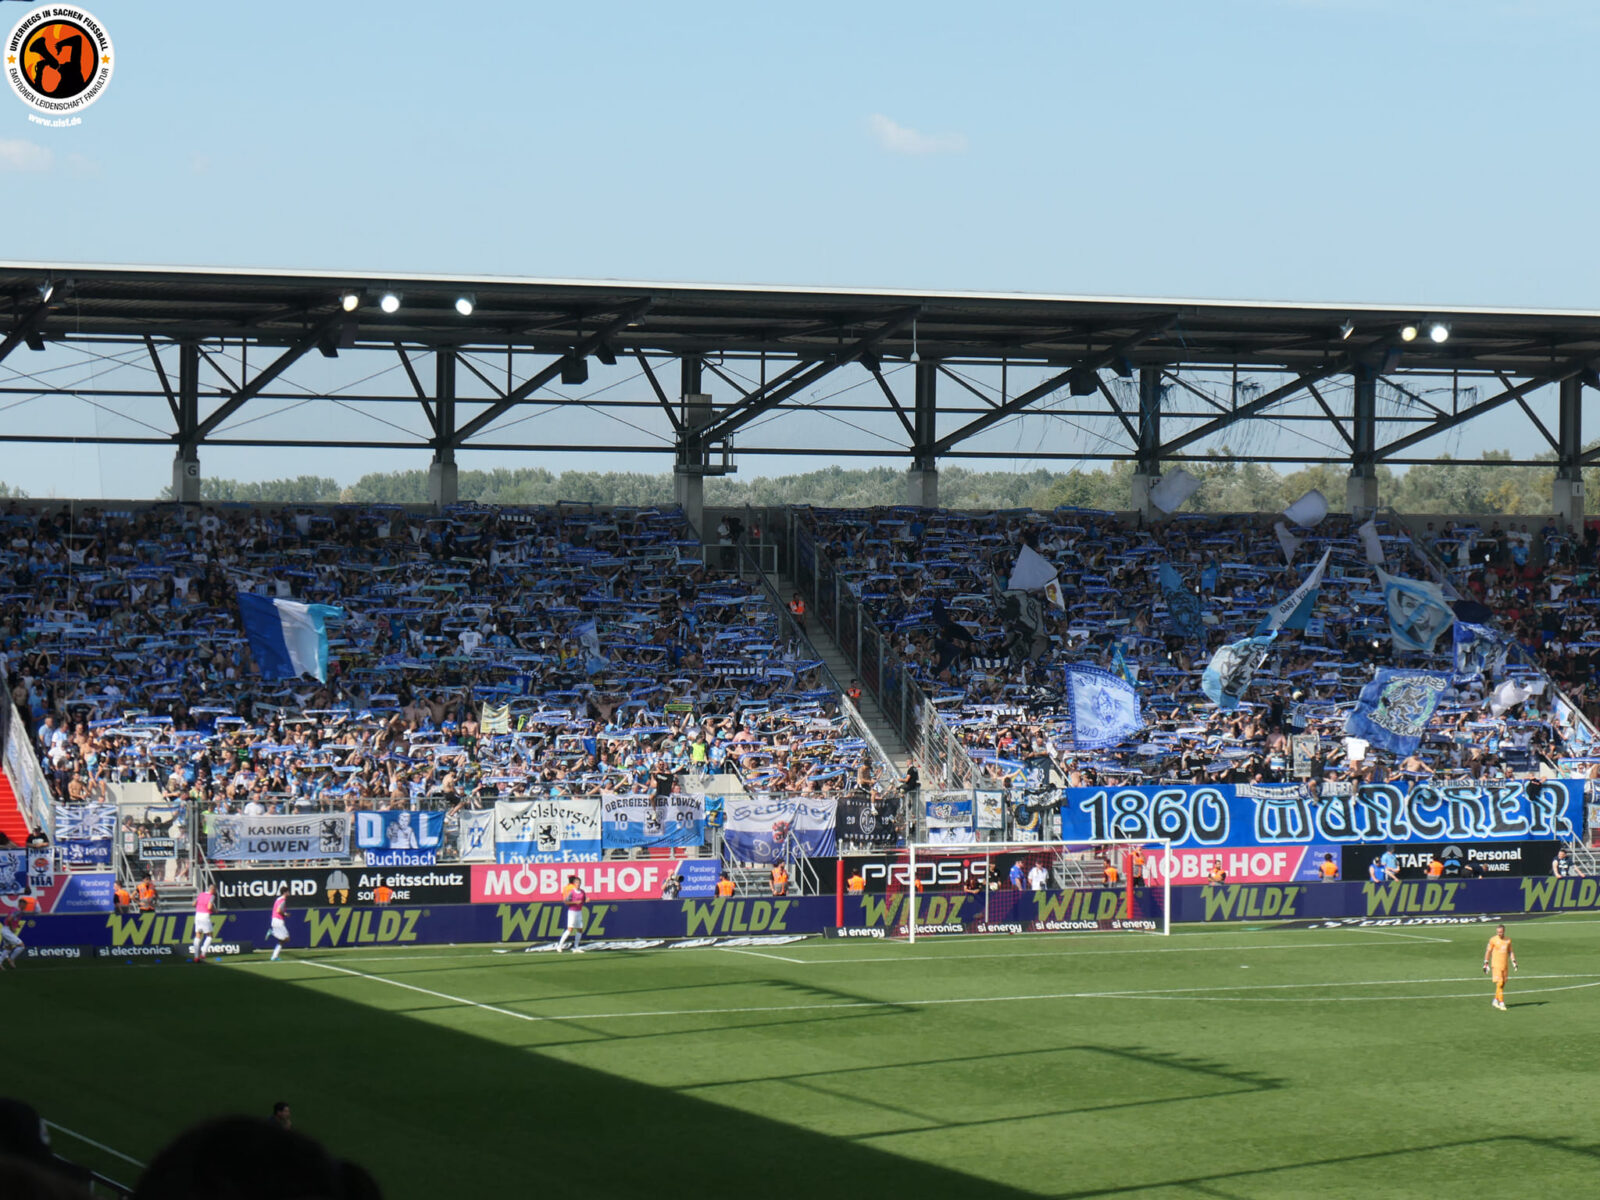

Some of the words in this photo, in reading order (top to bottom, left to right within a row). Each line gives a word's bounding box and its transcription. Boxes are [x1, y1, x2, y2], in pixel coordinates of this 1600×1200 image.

[188, 464, 197, 476] G
[499, 803, 598, 832] Engelsberger
[1079, 788, 1230, 846] 1860
[247, 825, 311, 836] KASINGER
[357, 812, 385, 846] D
[419, 813, 440, 846] L
[247, 840, 310, 853] LÖWEN
[366, 850, 437, 866] Buchbach
[1396, 853, 1434, 868] TAFF
[1468, 848, 1522, 861] Personal
[1200, 884, 1300, 921] WILDZ
[1361, 879, 1460, 917] WILDZ
[681, 896, 792, 936] WILDZ
[303, 907, 422, 947] WILDZ
[978, 922, 987, 932] si
[988, 924, 1022, 934] energy
[1036, 920, 1044, 930] si
[1046, 919, 1098, 929] electronics
[1112, 919, 1121, 929] si
[1122, 921, 1156, 931] energy
[838, 927, 847, 937] si
[849, 928, 885, 939] energy
[28, 946, 38, 957] si
[40, 947, 80, 959] energy
[99, 945, 110, 956] si
[111, 945, 172, 956] electronics
